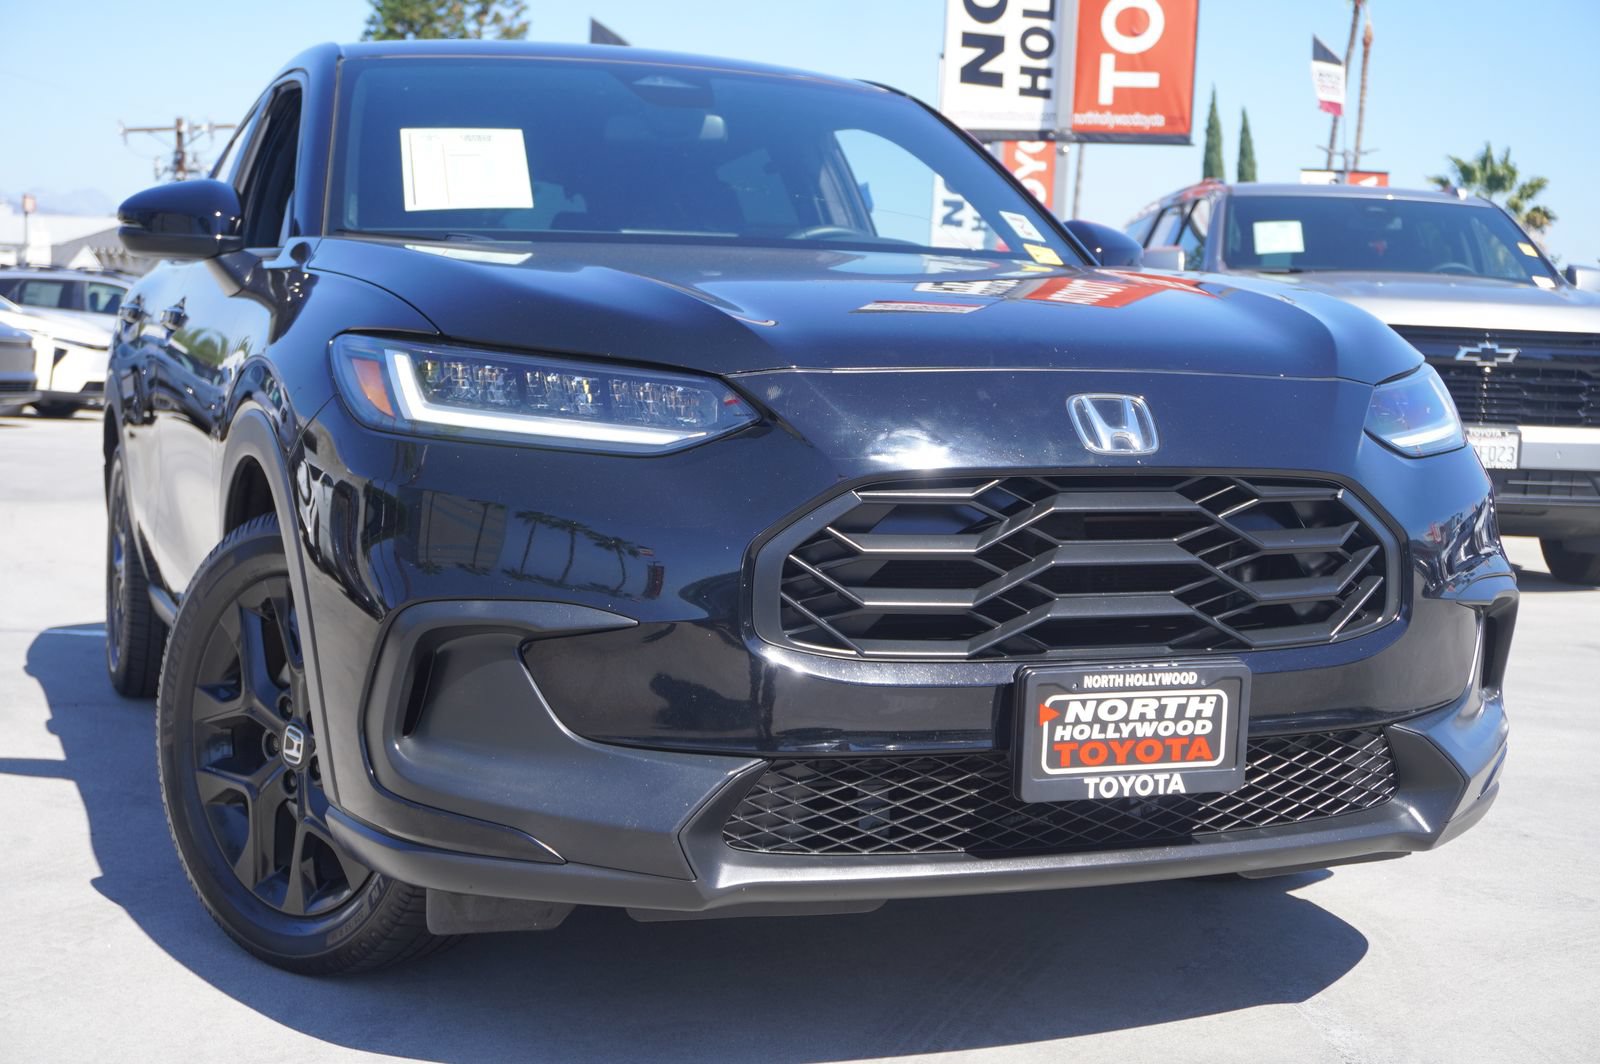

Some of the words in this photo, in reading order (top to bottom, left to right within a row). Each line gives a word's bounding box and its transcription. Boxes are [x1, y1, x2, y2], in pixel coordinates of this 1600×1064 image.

[1083, 674, 1123, 689] NORTH
[1125, 671, 1198, 688] HOLLYWOOD
[1064, 696, 1218, 723] NORTH
[1054, 719, 1213, 742] HOLLYWOOD
[1053, 735, 1214, 768] TOYOTA
[1084, 772, 1187, 799] TOYOTA
